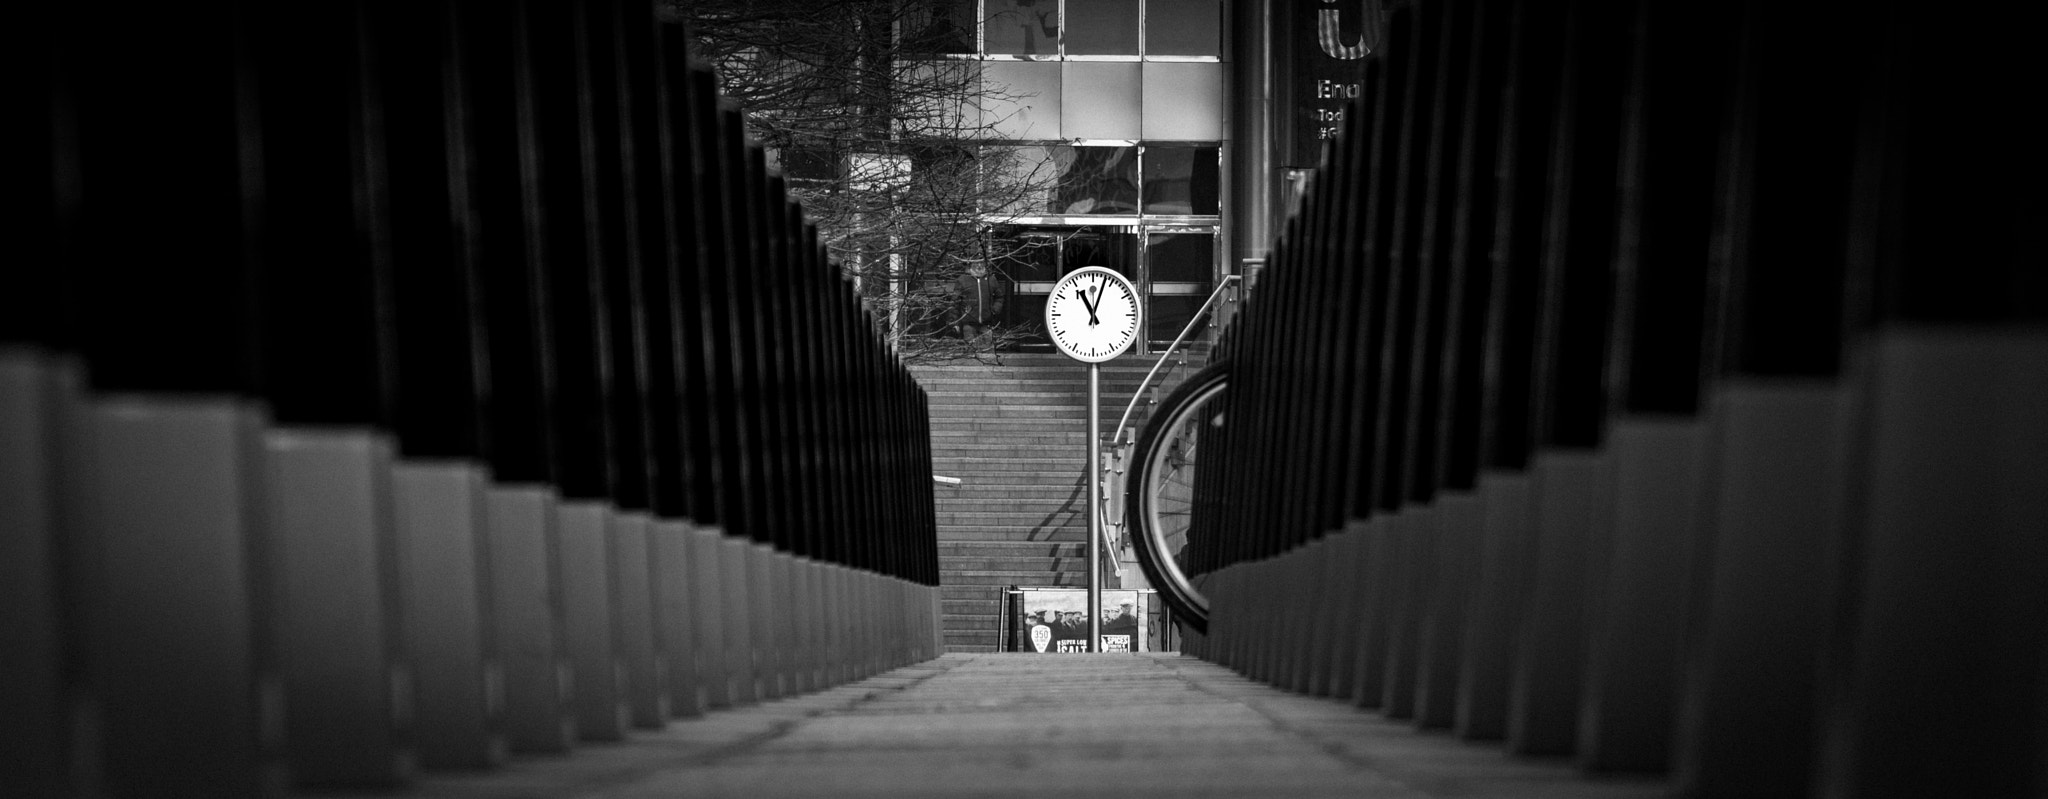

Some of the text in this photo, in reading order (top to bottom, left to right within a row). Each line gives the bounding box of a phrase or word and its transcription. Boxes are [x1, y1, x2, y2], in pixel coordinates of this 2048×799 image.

[1317, 108, 1344, 122] Tod
[1317, 127, 1337, 140] #G
[1035, 630, 1049, 639] 350
